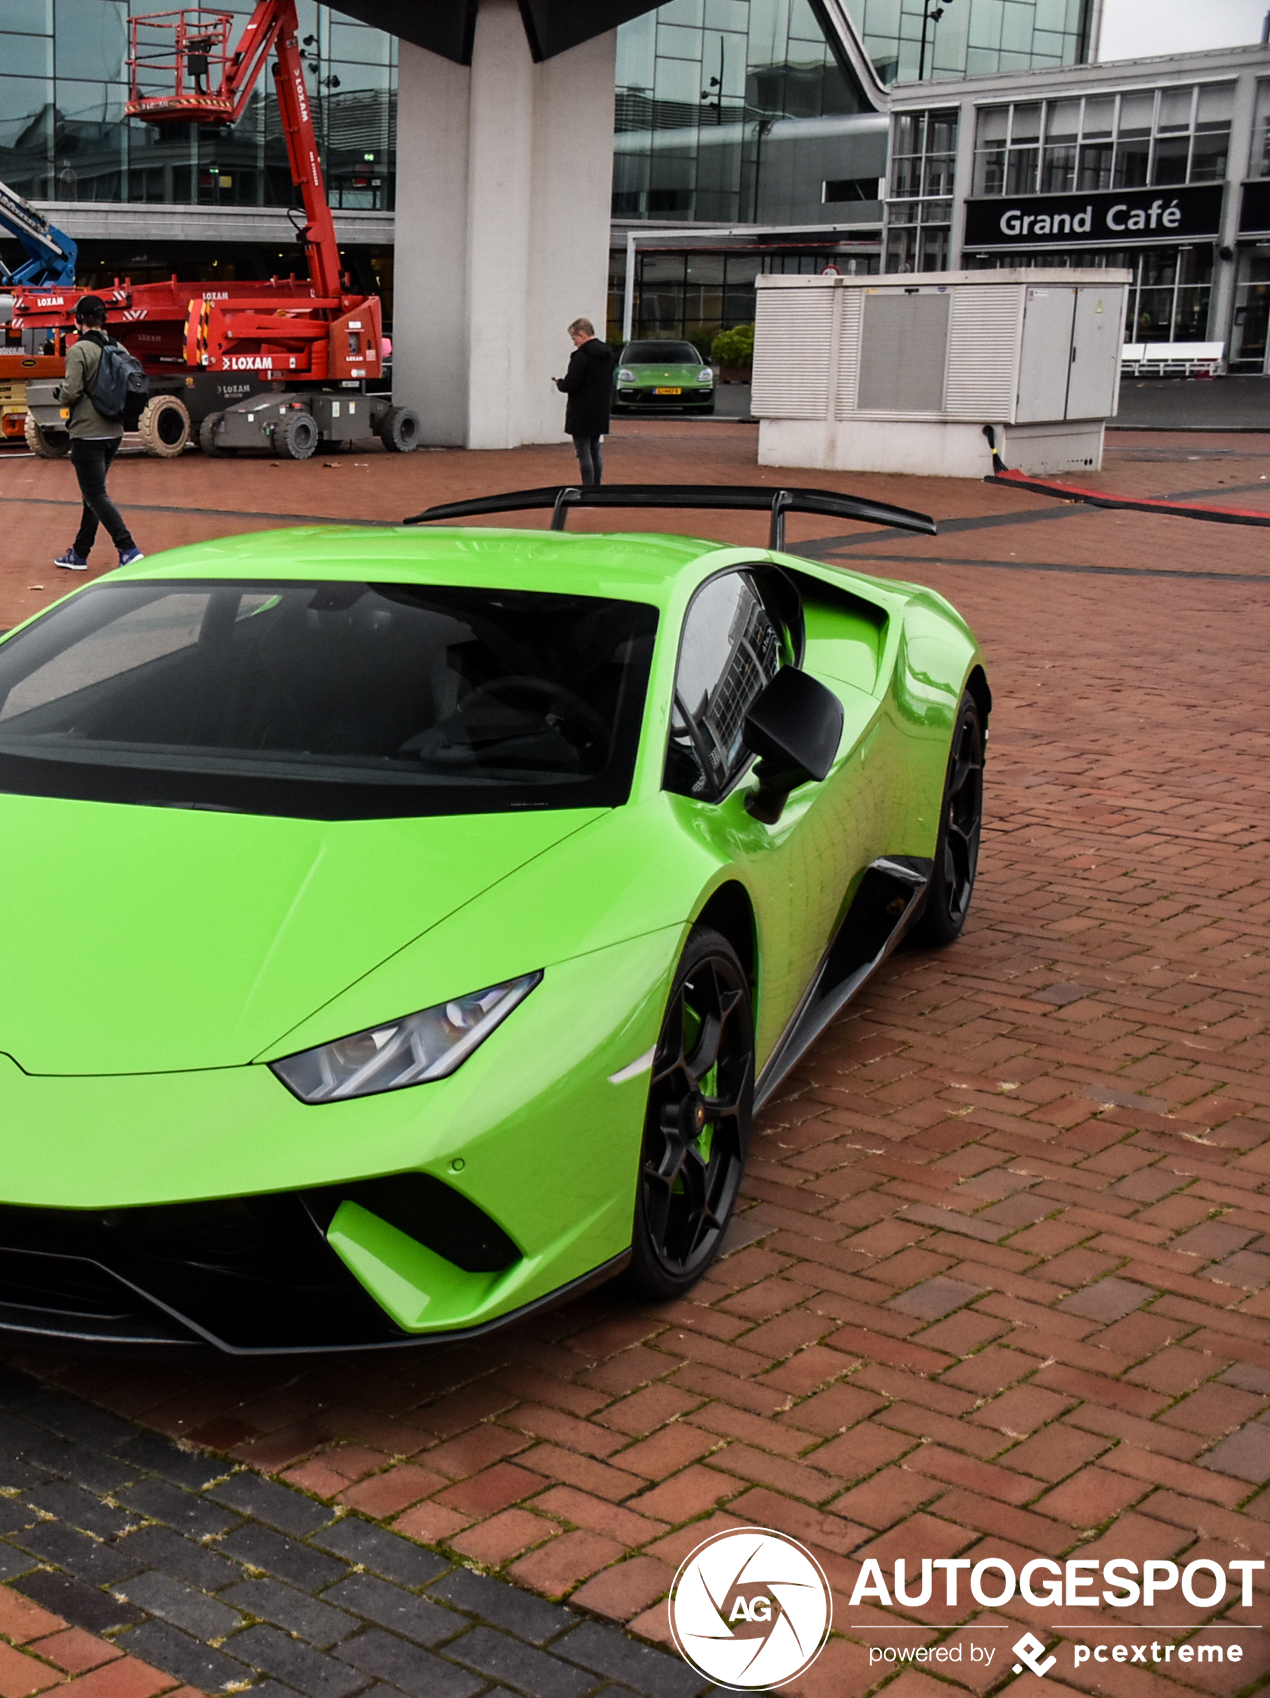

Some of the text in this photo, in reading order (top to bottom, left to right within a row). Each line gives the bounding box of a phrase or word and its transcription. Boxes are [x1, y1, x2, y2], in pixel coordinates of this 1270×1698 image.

[295, 78, 309, 122] LOXAM
[1000, 199, 1181, 236] Grand Café
[202, 292, 229, 301] LOXAM
[37, 297, 65, 307] LOXAM
[138, 334, 161, 342] LOXAM
[232, 356, 273, 370] LOXAM
[223, 384, 251, 394] LOXAM
